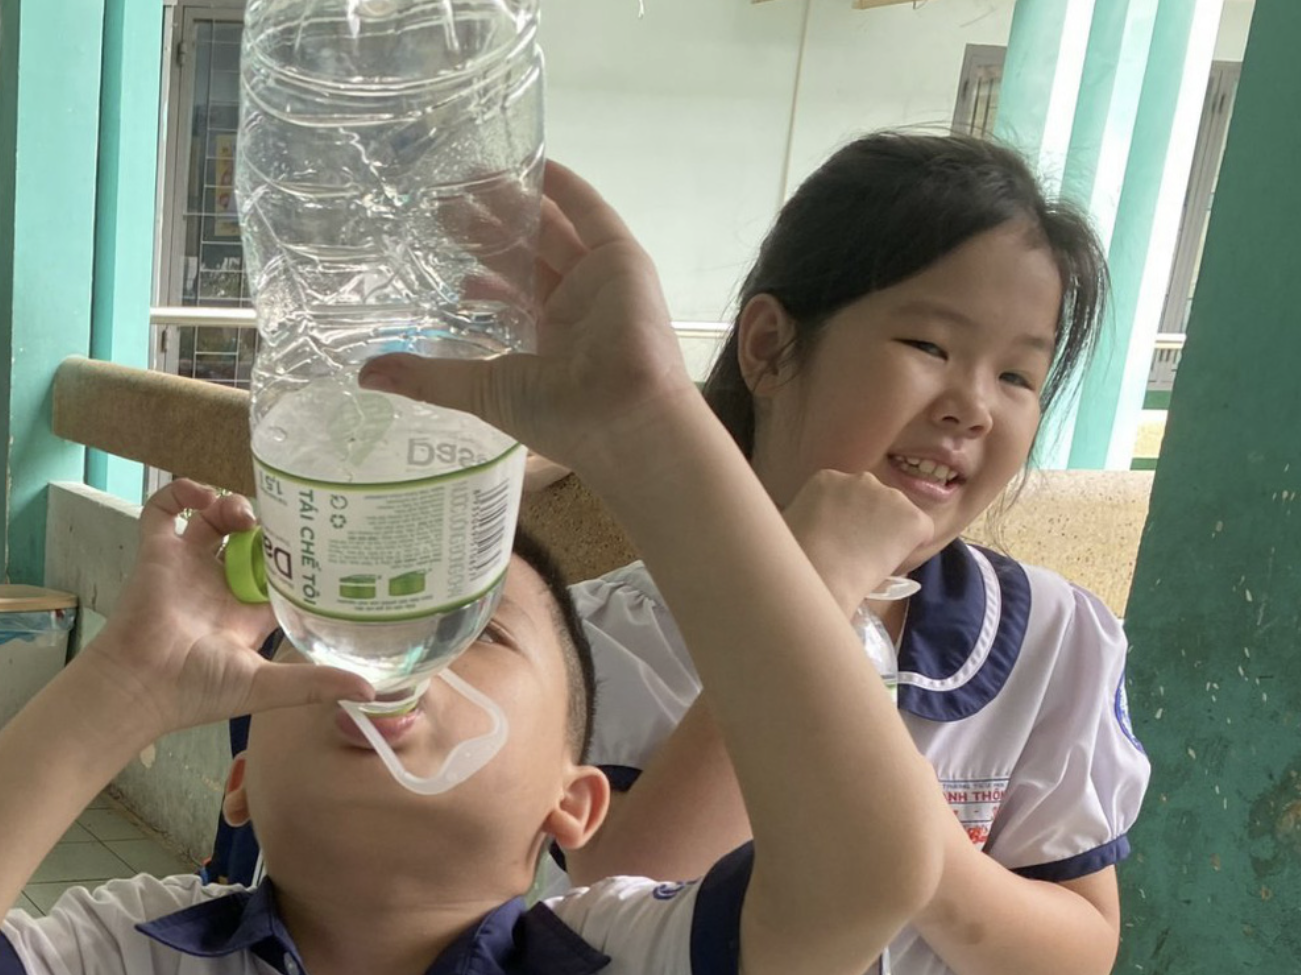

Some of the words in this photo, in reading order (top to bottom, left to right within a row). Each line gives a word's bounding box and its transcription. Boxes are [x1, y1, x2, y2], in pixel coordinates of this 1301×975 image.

[299, 490, 319, 521] TÁI
[301, 526, 322, 572] CHẾ
[303, 575, 321, 605] TÔI
